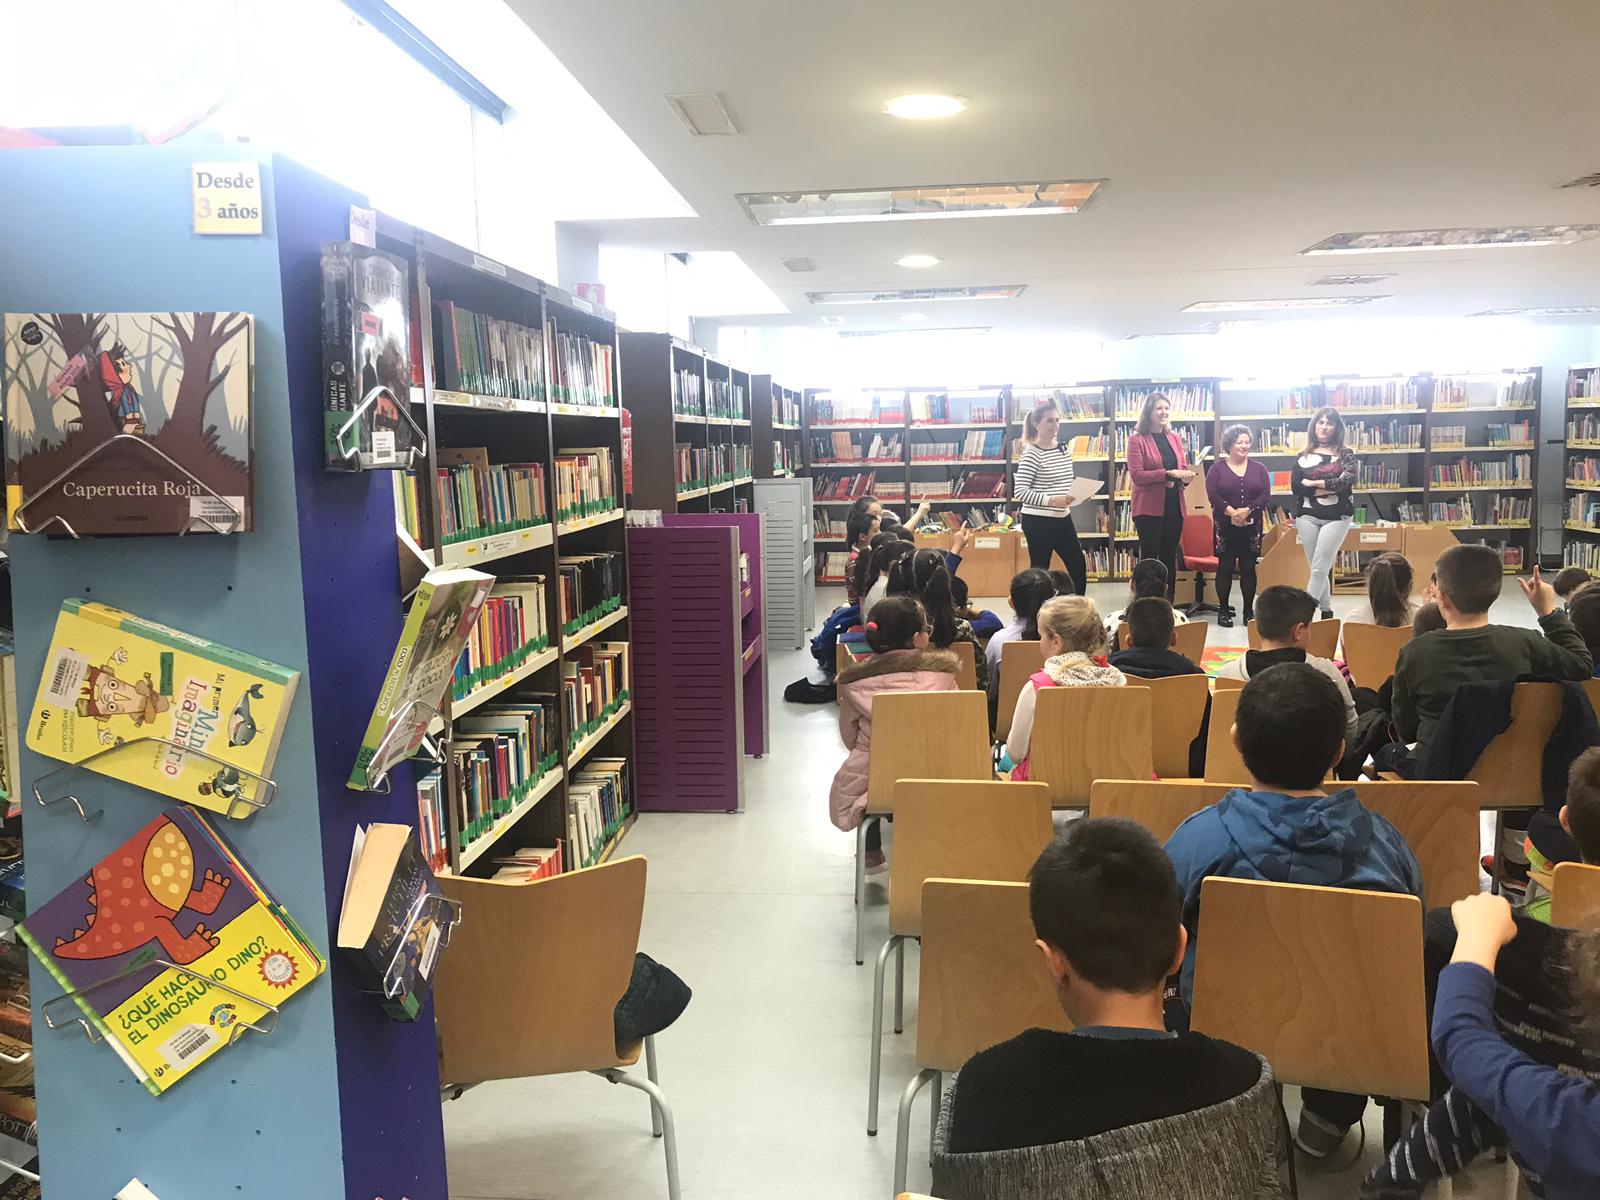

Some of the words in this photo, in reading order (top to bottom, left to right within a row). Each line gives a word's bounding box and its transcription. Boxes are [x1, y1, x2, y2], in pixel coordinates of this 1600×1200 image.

[196, 172, 254, 189] Desde
[197, 197, 212, 218] 3
[217, 202, 259, 219] años
[63, 481, 158, 500] Caperucita
[163, 480, 201, 499] Roja
[216, 673, 226, 684] Mi
[211, 685, 222, 716] primer
[165, 679, 208, 775] Imaginario
[187, 708, 219, 755] Min
[118, 991, 160, 1030] ¿QUÉ
[159, 972, 197, 1001] HACE
[127, 1028, 149, 1046] EL
[226, 935, 268, 972] DINO?
